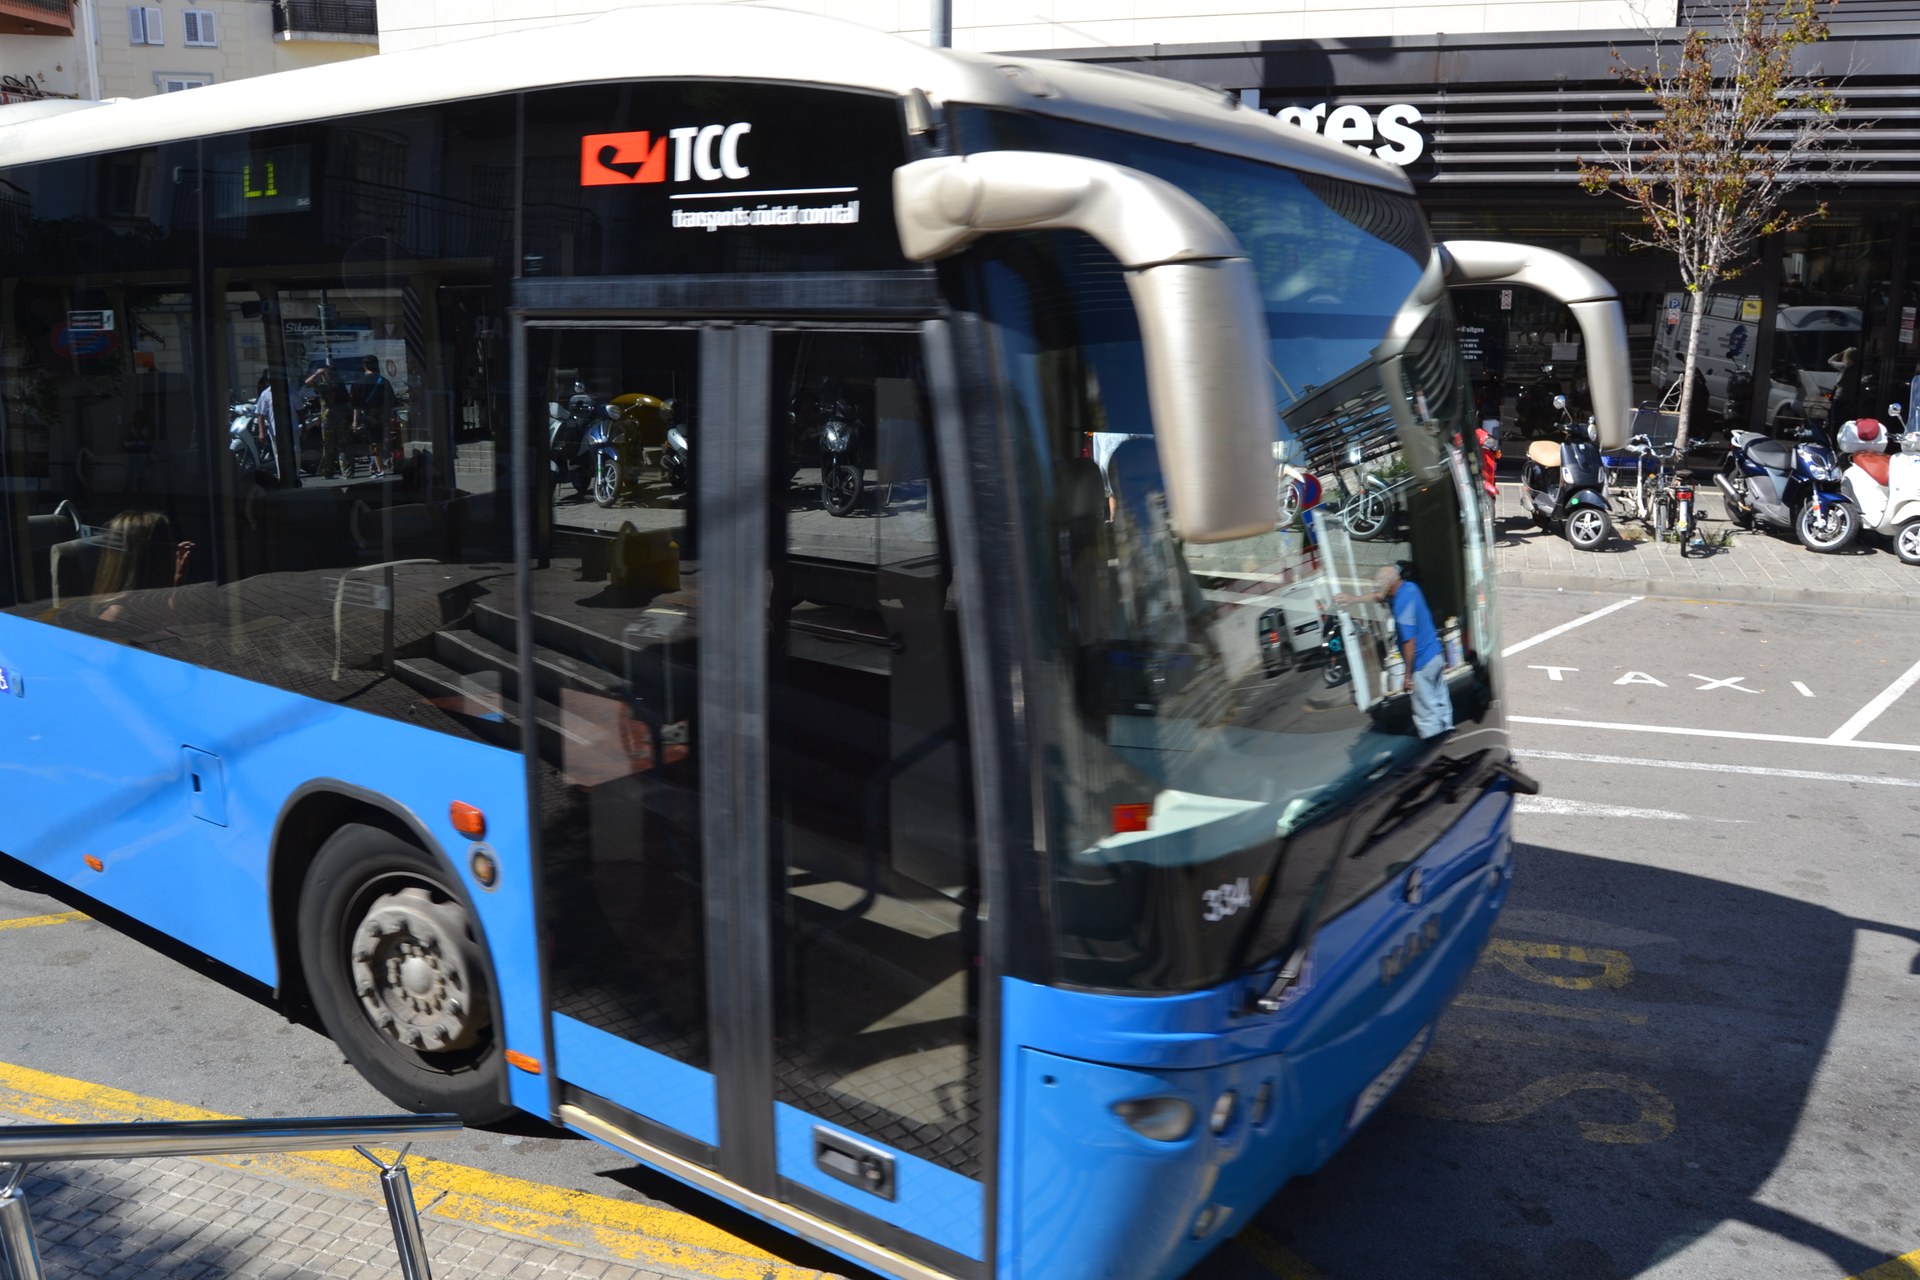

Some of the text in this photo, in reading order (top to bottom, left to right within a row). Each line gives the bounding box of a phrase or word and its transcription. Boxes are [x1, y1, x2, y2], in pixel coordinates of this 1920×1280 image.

[669, 121, 752, 182] TCC
[243, 162, 277, 197] L1
[1527, 664, 1817, 698] TAXI
[1201, 877, 1252, 921] 334
